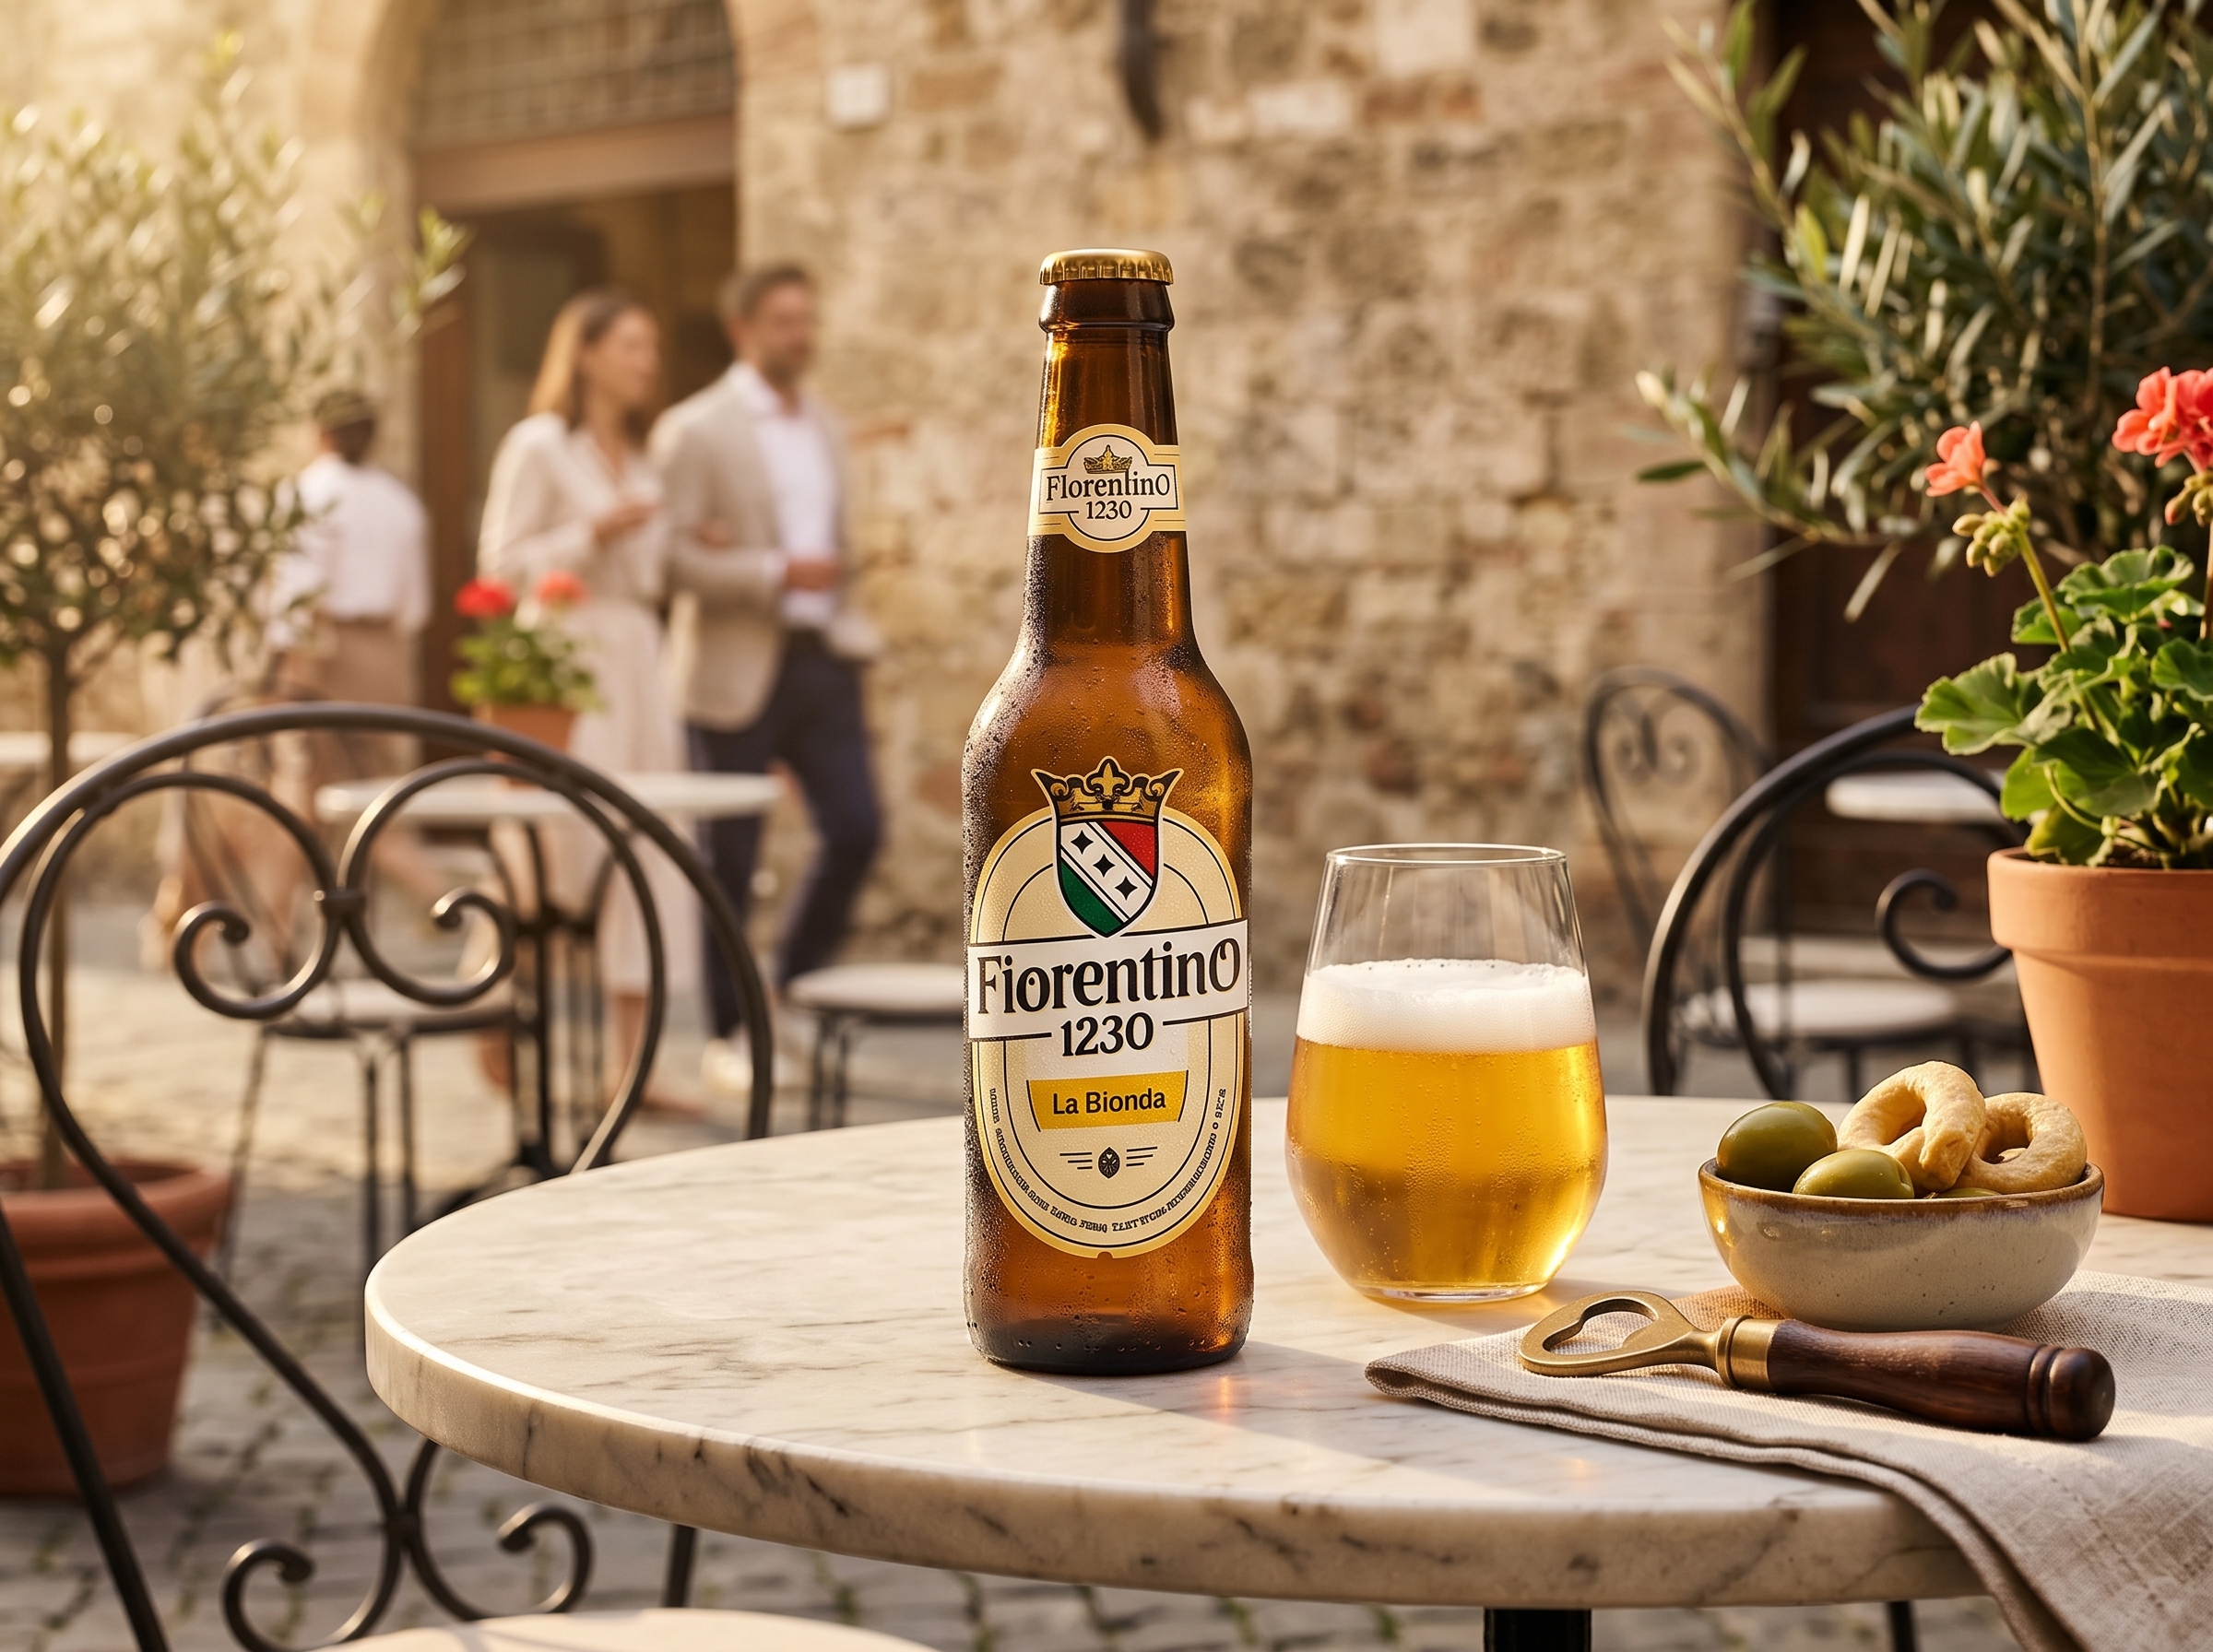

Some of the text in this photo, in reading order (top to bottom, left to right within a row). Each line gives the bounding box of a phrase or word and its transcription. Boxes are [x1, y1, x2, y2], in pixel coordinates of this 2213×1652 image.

[1085, 500, 1132, 520] 1230
[1059, 1011, 1154, 1057] 1230
[1053, 1088, 1166, 1115] La Bionda
